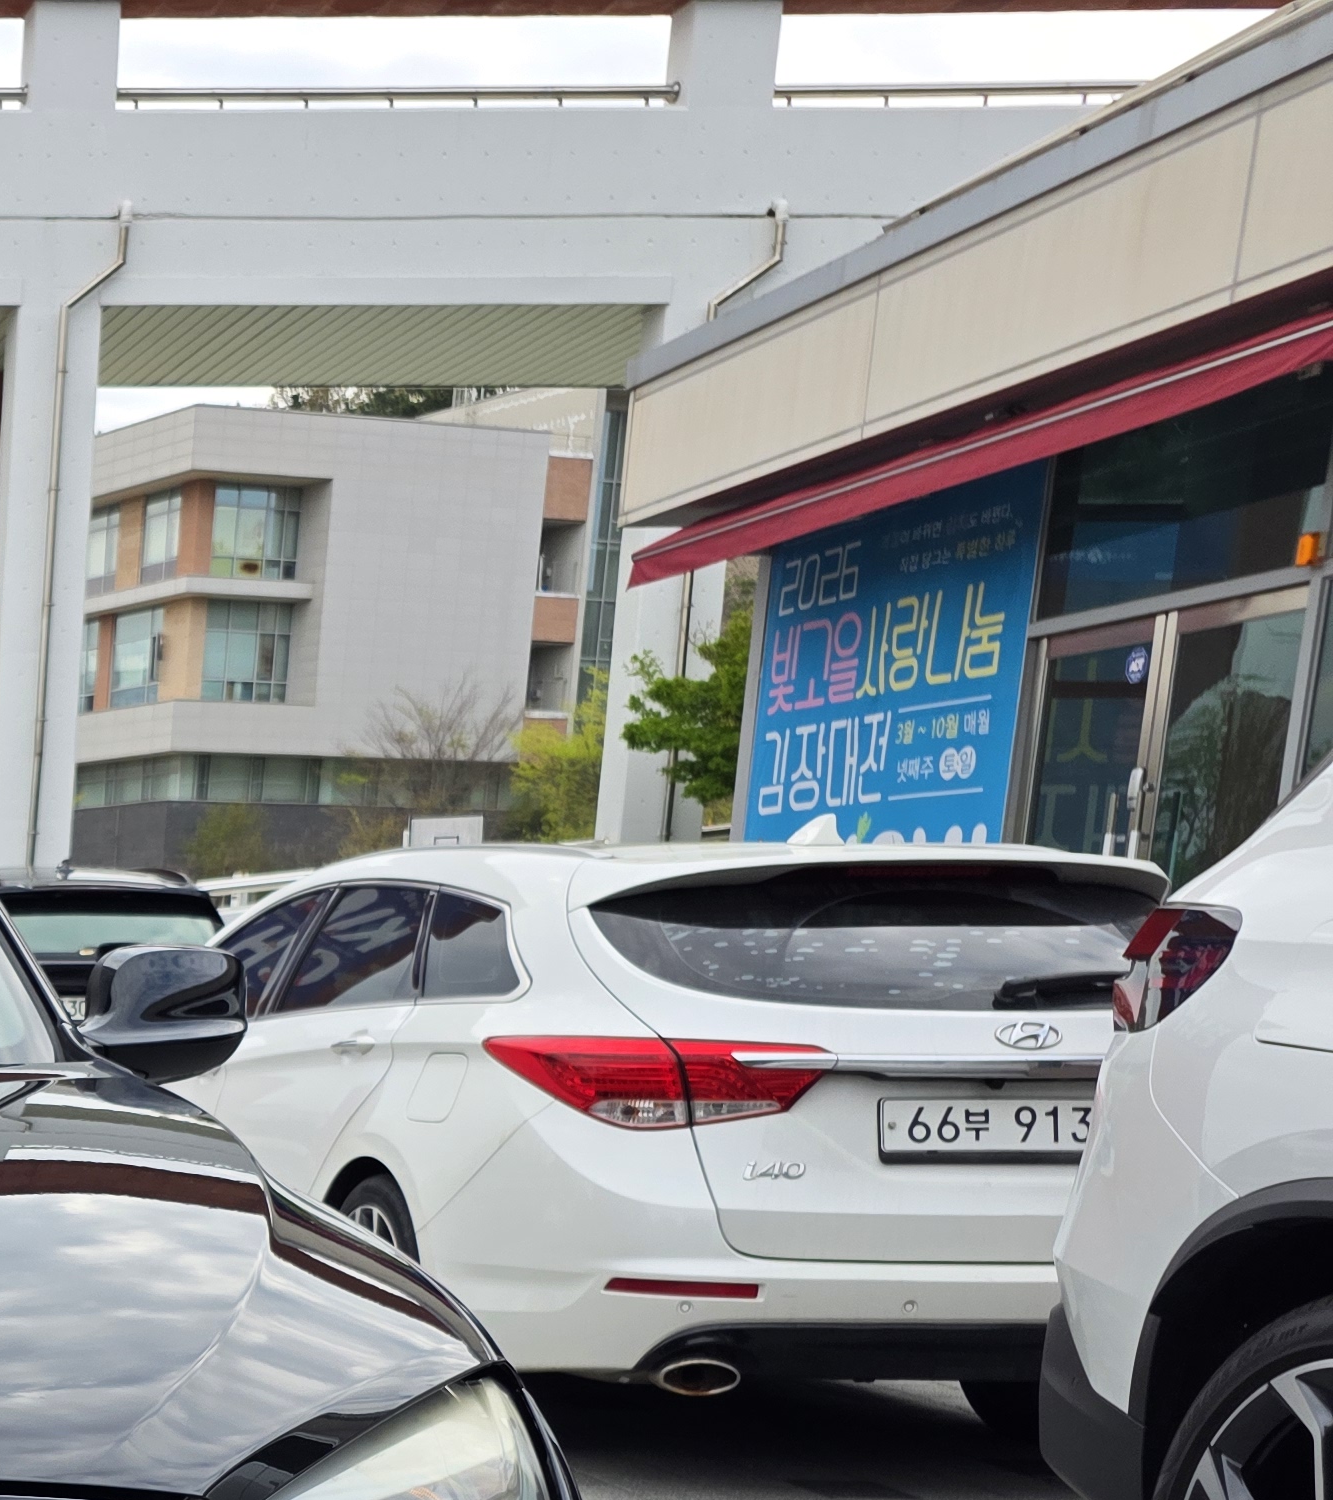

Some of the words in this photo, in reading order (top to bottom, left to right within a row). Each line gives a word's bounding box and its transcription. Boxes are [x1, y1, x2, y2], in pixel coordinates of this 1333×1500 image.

[778, 540, 862, 618] 2026
[895, 719, 915, 745] 3월
[931, 711, 960, 739] 10월
[963, 708, 990, 736] 매월
[758, 709, 892, 816] 김장대전
[896, 755, 934, 784] 넷째주
[907, 1106, 990, 1144] 66부
[1014, 1106, 1092, 1144] 913
[742, 1160, 806, 1181] i40
